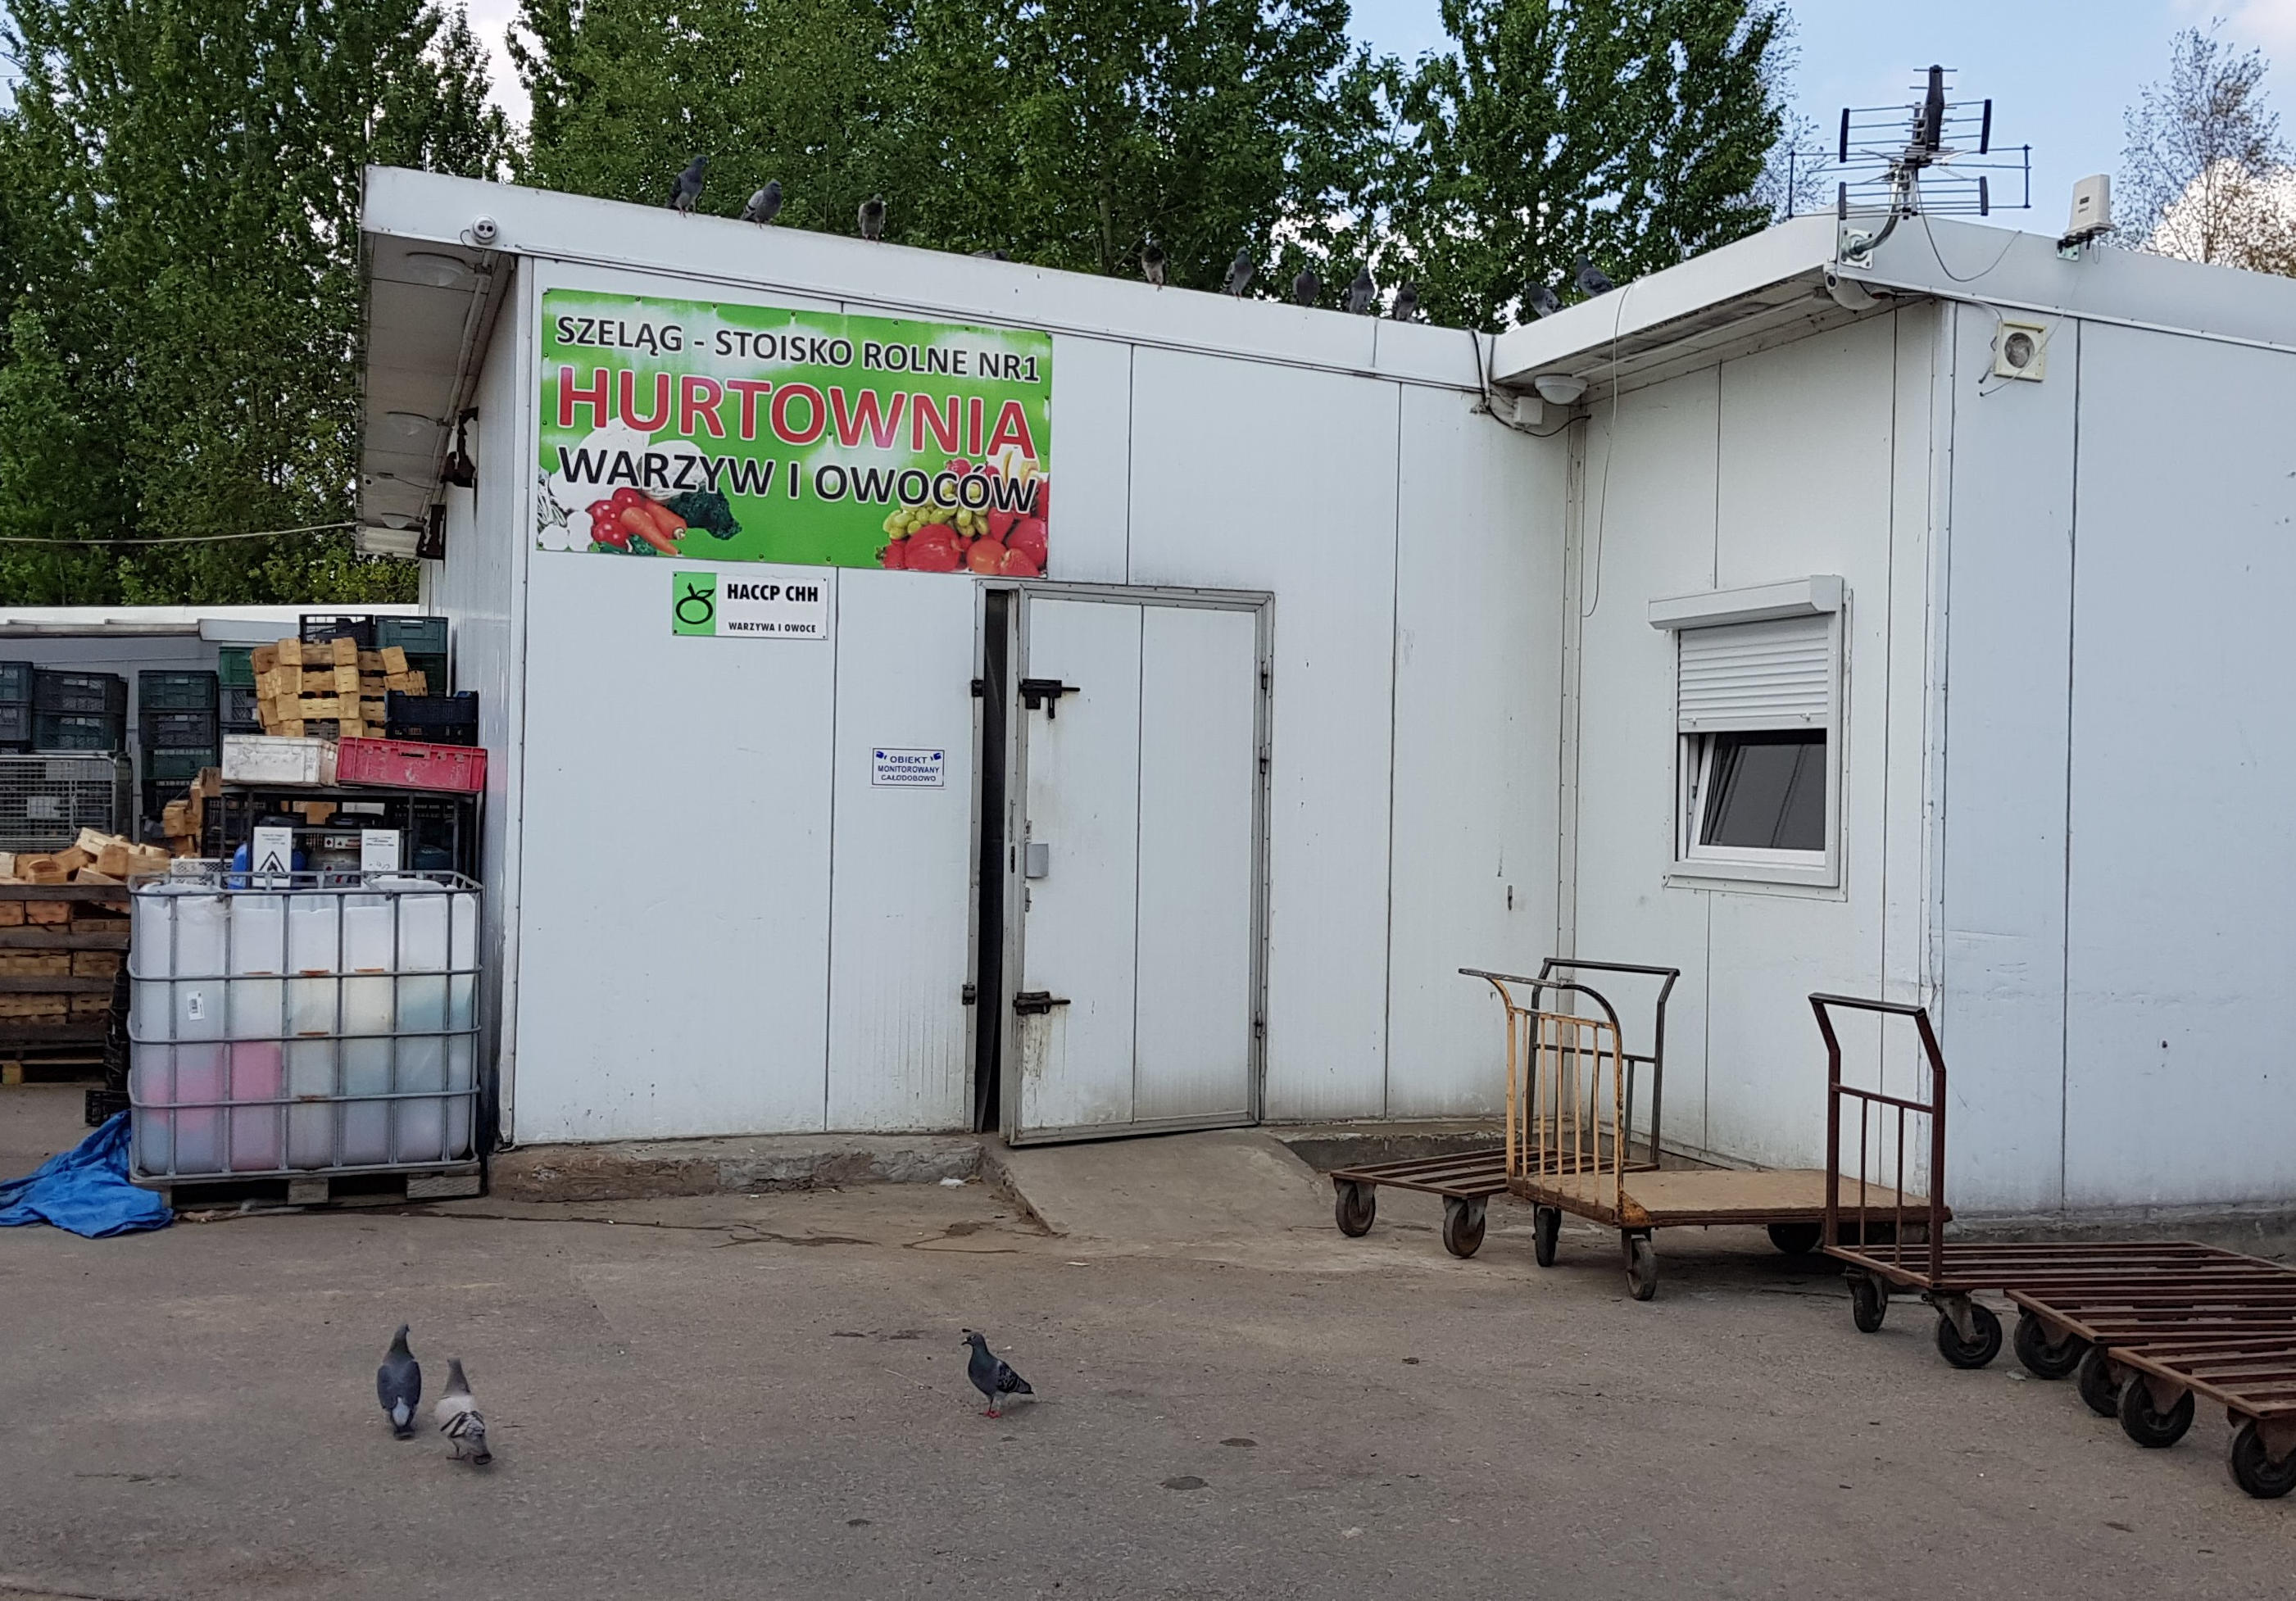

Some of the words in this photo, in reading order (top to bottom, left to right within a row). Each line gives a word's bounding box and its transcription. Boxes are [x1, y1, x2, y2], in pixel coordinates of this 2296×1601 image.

[556, 315, 683, 356] SZELĄG
[715, 330, 853, 367] STOISKO
[864, 342, 968, 376] ROLNE
[979, 352, 1040, 383] NR1
[557, 366, 1036, 460] HURTOWNIA
[558, 446, 774, 497] WARZYW
[789, 462, 798, 498] I
[815, 462, 1036, 513] OWOCÓW
[727, 583, 781, 601] HACCP
[785, 585, 819, 602] CHH
[728, 621, 775, 632] WARZYWA
[784, 623, 817, 633] OWOCE
[889, 755, 928, 764] OBIEKT
[877, 764, 940, 773] MONITOROWANY
[881, 773, 937, 782] CAŁODOBOWO
